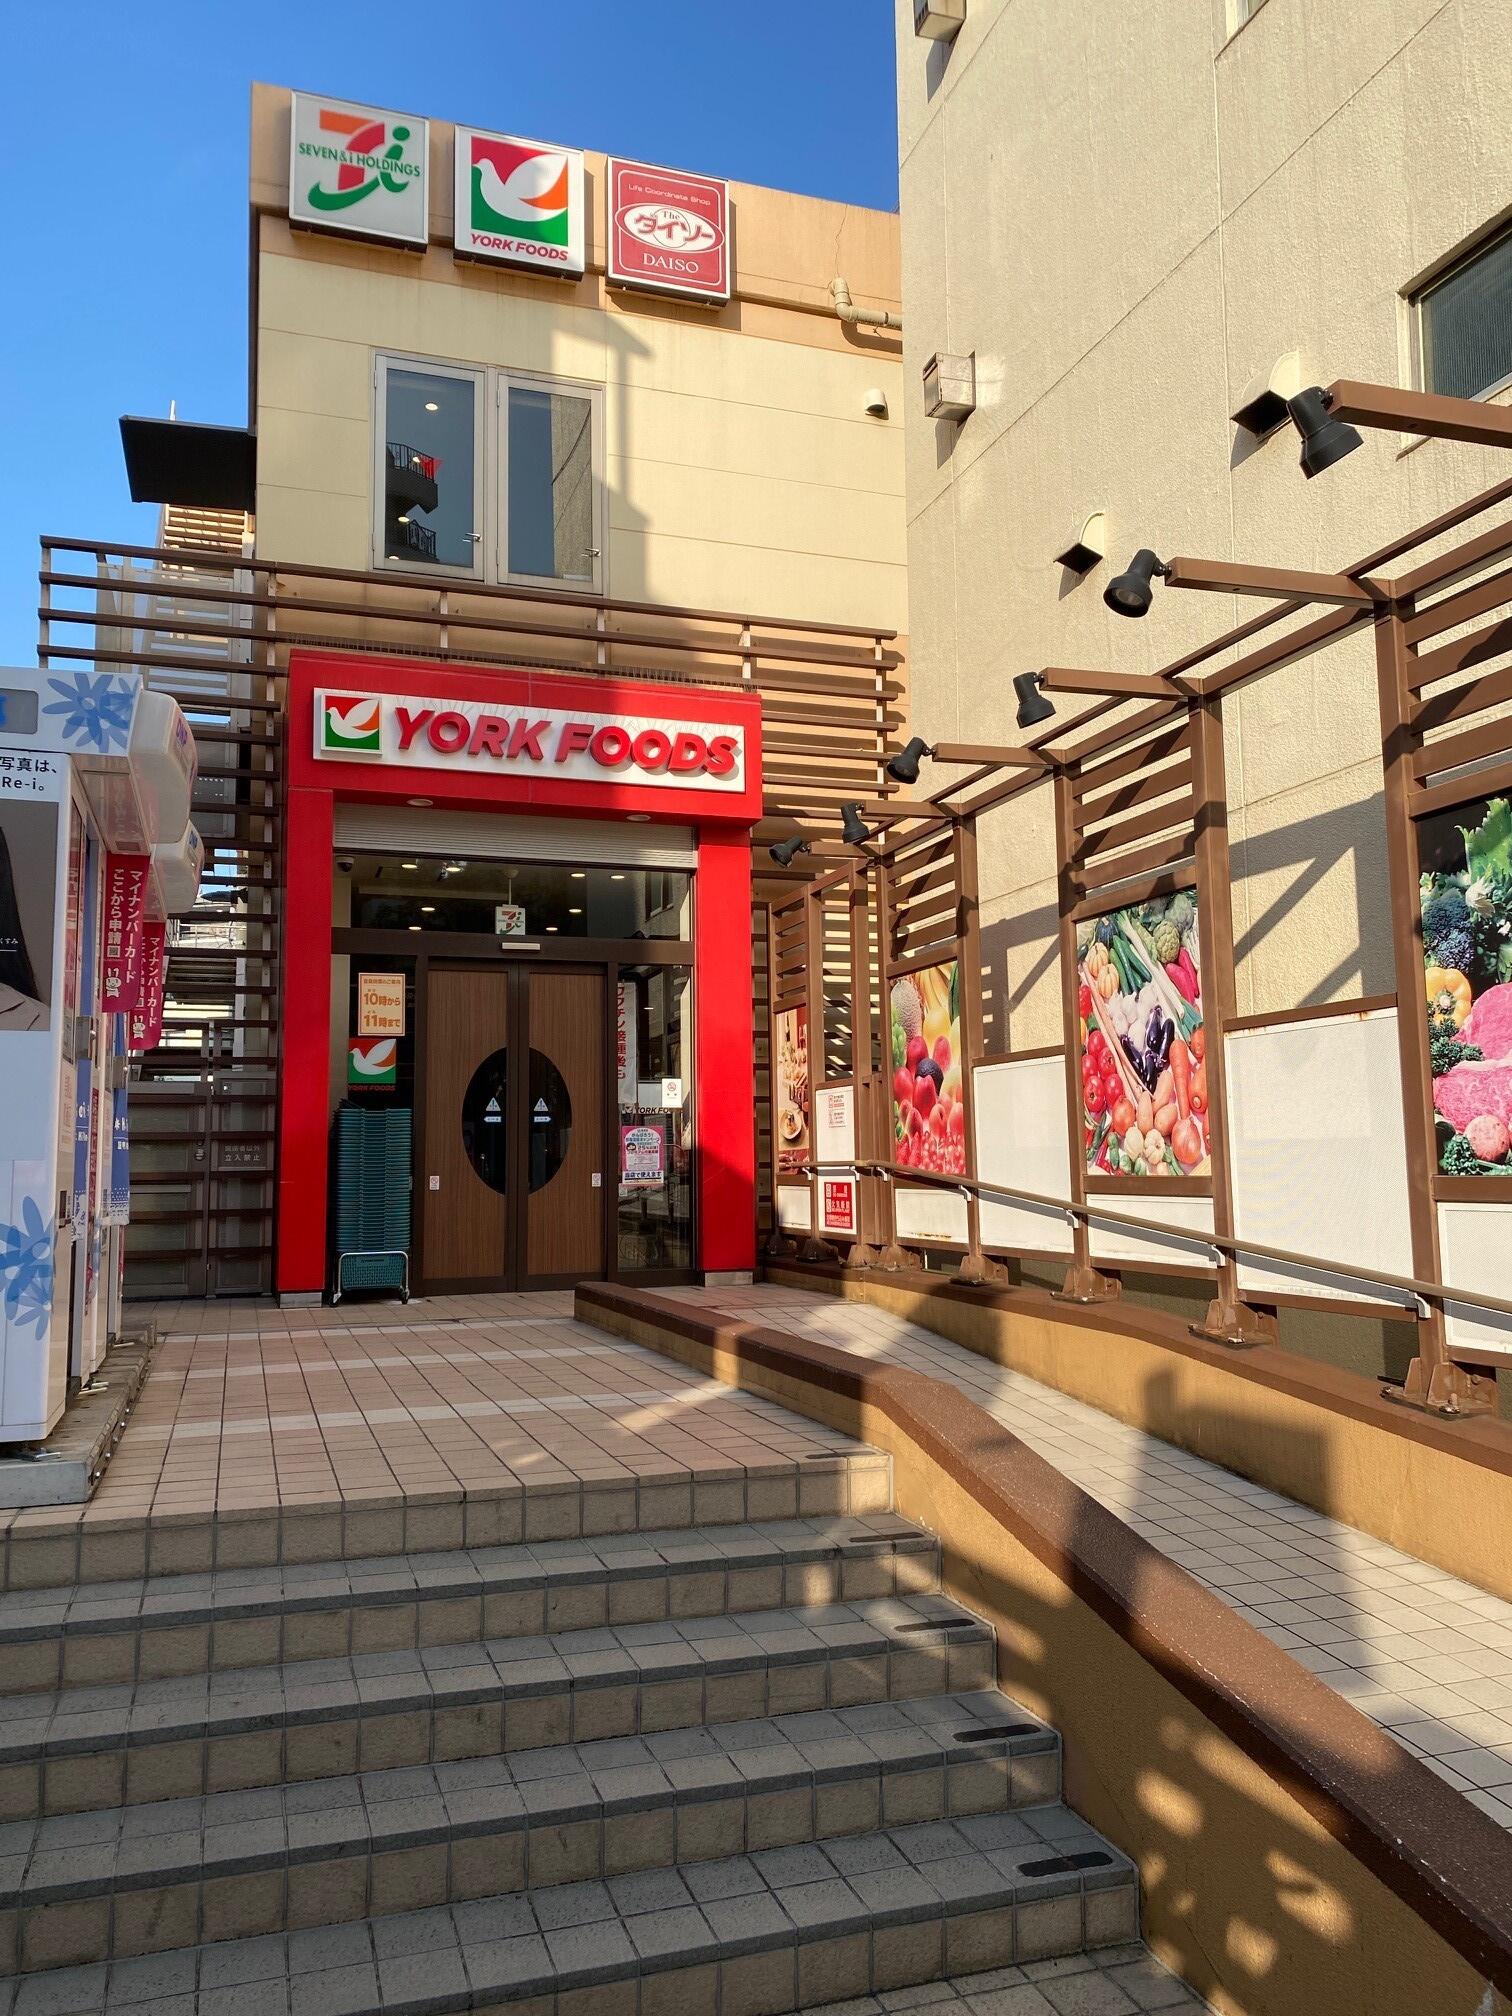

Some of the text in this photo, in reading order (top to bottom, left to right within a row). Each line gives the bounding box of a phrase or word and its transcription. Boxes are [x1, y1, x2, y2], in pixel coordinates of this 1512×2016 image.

[356, 154, 421, 178] HOLDINGS
[628, 183, 711, 206] Life Coordinate Shop
[634, 211, 714, 243] ダイソー
[662, 210, 681, 221] The
[471, 233, 569, 261] YORK FOODS
[642, 252, 699, 274] DAISO
[394, 706, 738, 776] YORK FOODS
[124, 870, 143, 984] マイナンバーカード
[147, 937, 161, 1028] マイナンバーカード
[224, 1153, 262, 1162] 立入禁止
